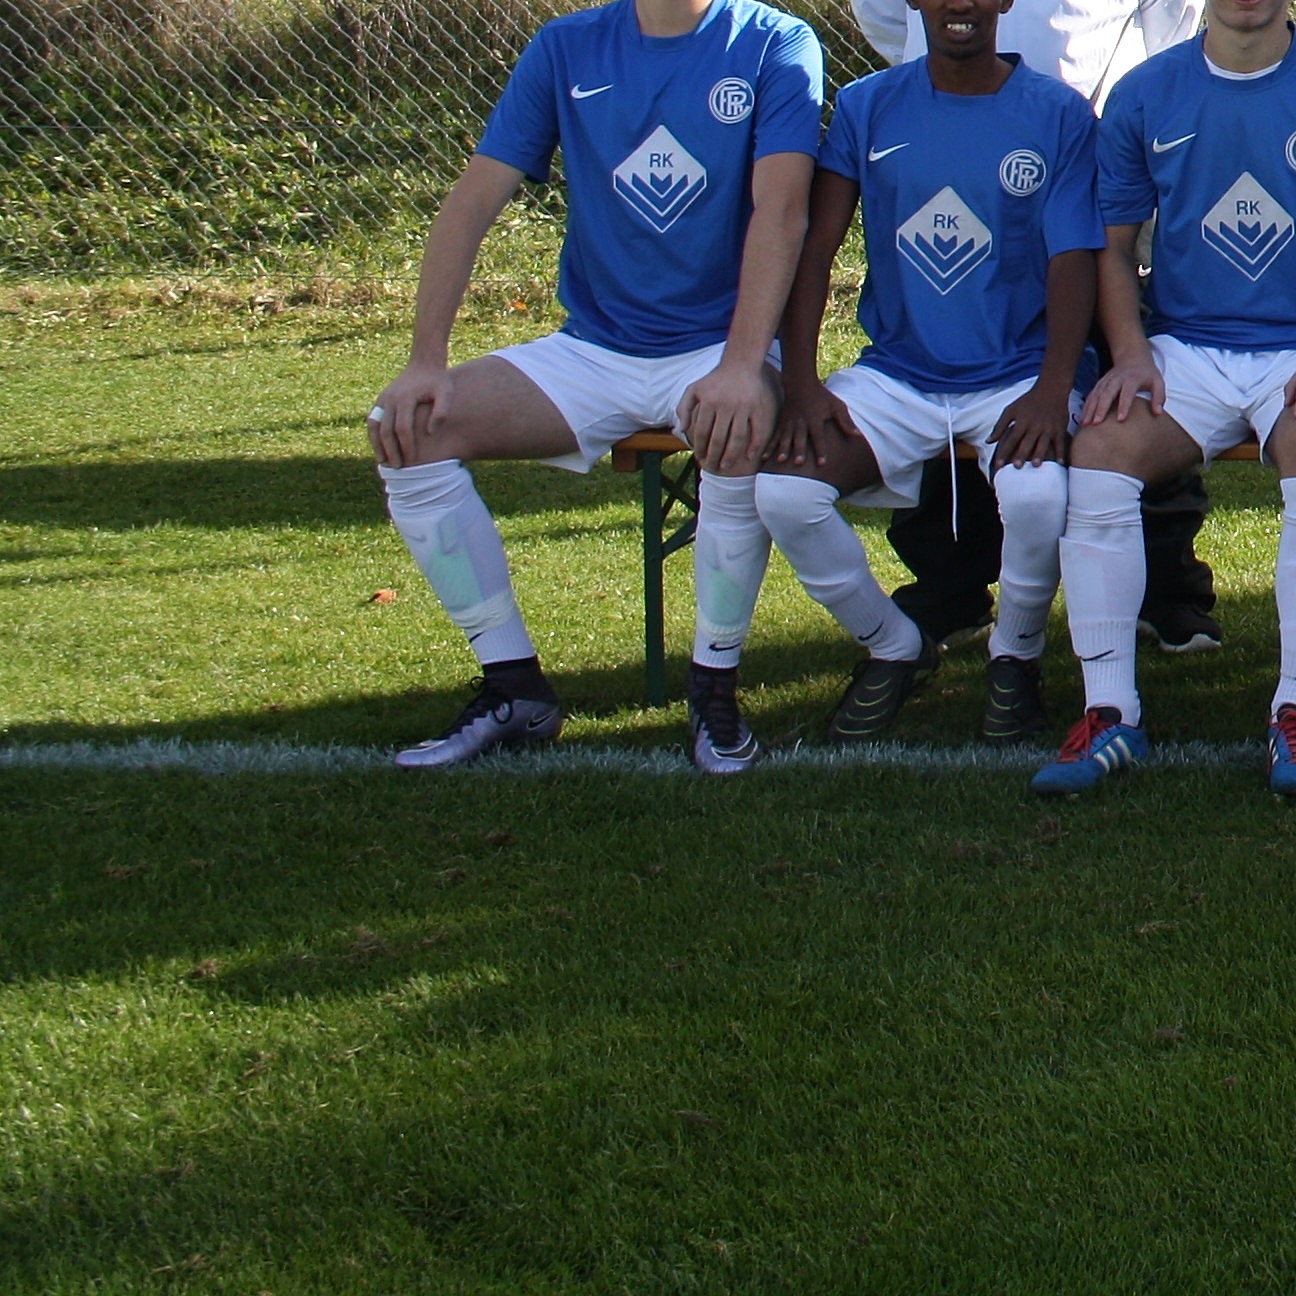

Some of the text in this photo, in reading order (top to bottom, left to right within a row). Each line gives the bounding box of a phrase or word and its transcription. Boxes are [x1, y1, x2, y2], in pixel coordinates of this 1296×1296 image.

[648, 152, 674, 168] RK
[1235, 200, 1261, 216] RK
[933, 213, 959, 230] RK
